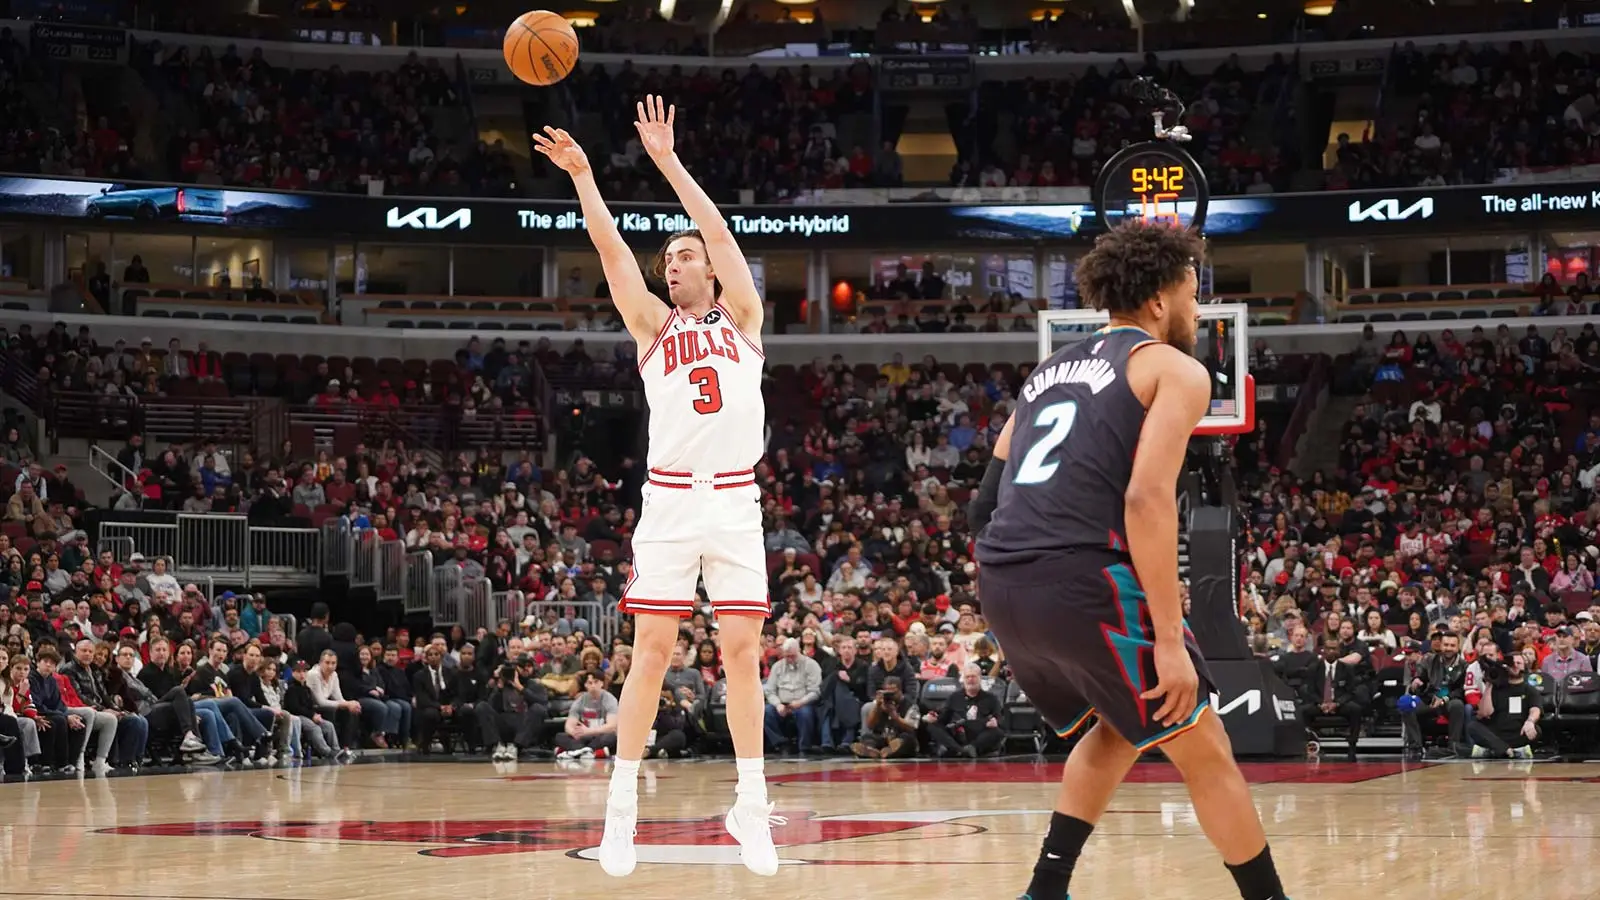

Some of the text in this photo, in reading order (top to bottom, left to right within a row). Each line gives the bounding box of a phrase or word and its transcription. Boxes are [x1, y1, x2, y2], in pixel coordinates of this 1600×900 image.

[1131, 166, 1184, 192] 9:42
[386, 206, 849, 237] KIA The all- Kia Tellu Turbo-Hybrid
[1348, 197, 1434, 222] KIA
[1481, 195, 1517, 213] The
[1520, 193, 1587, 212] all-new
[662, 327, 740, 377] BULLS
[688, 366, 723, 415] 3
[1013, 400, 1078, 485] 2
[1209, 689, 1261, 716] IA
